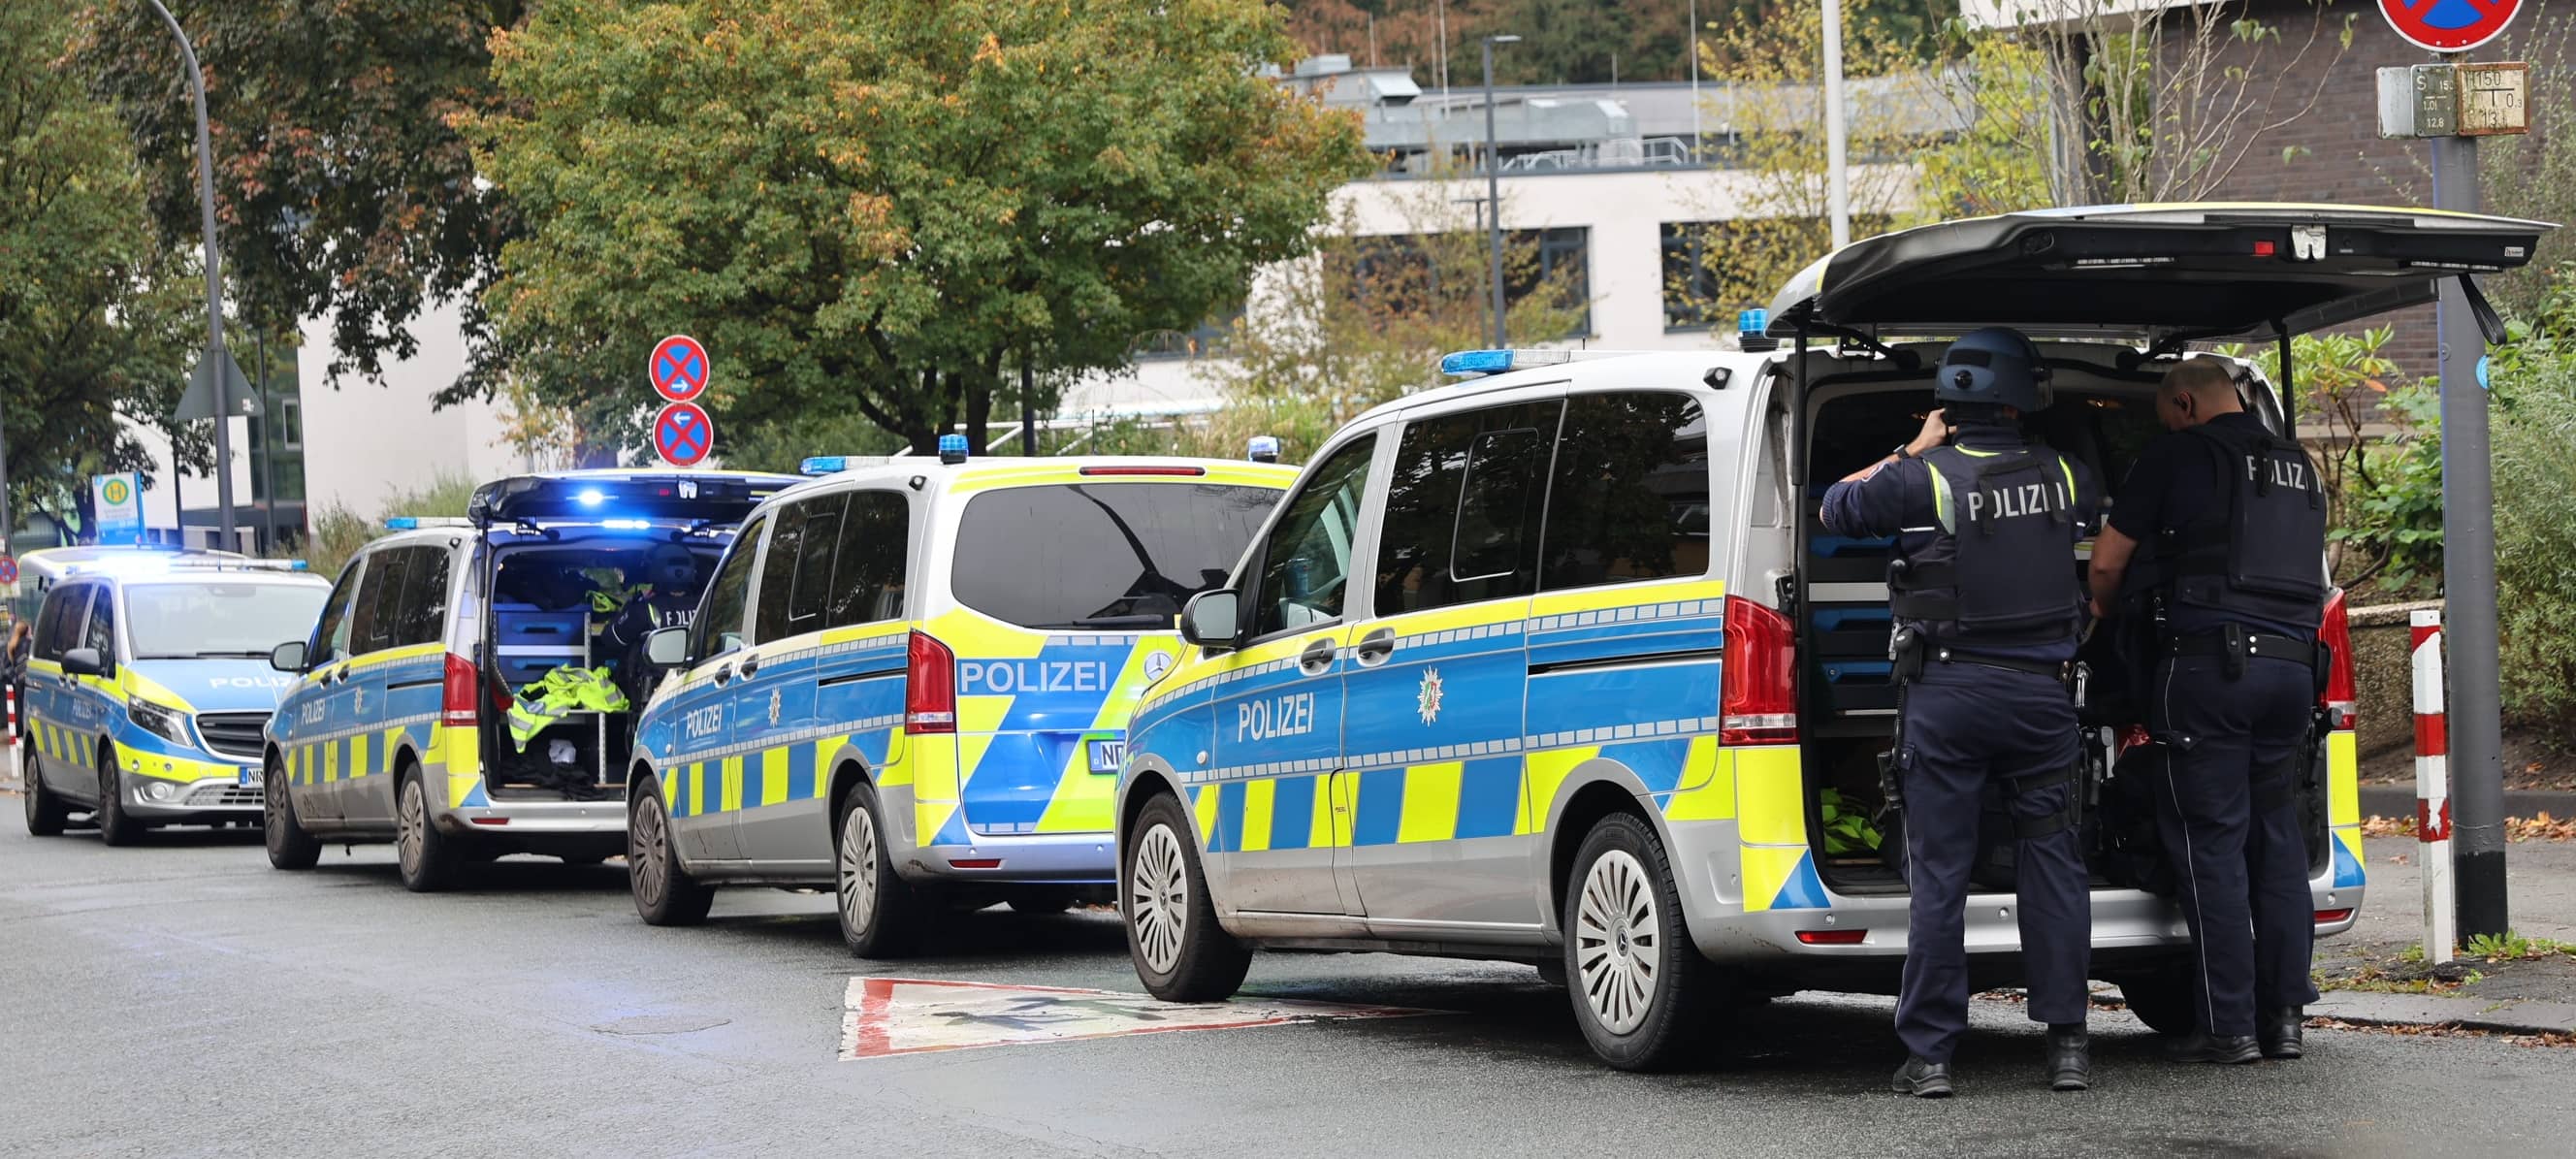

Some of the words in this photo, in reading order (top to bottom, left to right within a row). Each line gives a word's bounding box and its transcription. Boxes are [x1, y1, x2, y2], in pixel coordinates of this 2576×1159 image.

[110, 484, 122, 499] H
[2245, 455, 2322, 494] PLIZI
[960, 660, 1107, 692] POLIZEI
[301, 697, 326, 726] POLIZEI
[685, 702, 723, 741] POLIZEI
[1237, 692, 1314, 744] POLIZEI
